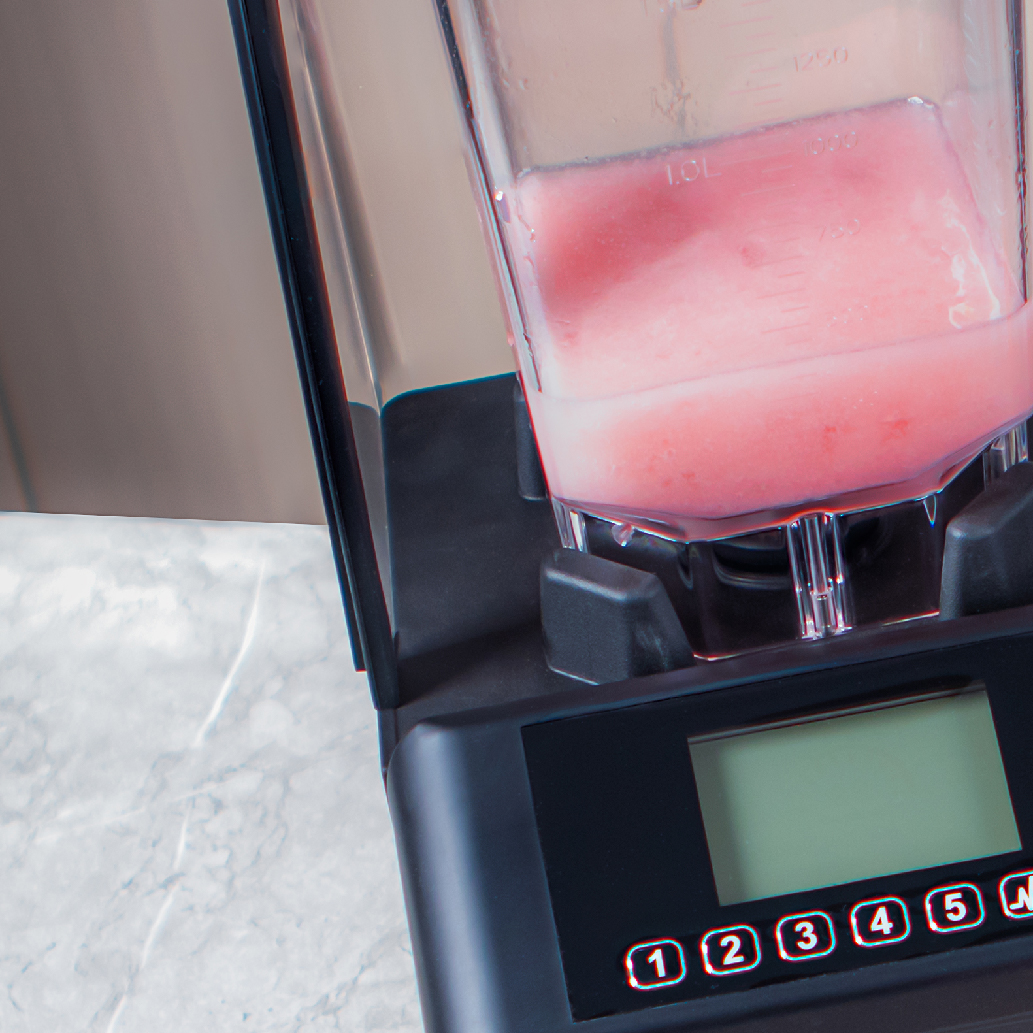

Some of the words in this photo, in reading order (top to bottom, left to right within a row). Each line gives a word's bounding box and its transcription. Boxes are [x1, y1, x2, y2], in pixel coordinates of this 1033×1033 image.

[793, 46, 849, 72] 1250
[666, 157, 722, 186] 1.0L
[647, 948, 666, 978] 1
[720, 934, 745, 966] 2
[794, 920, 818, 951] 3
[869, 905, 894, 935] 4
[944, 892, 967, 922] 5
